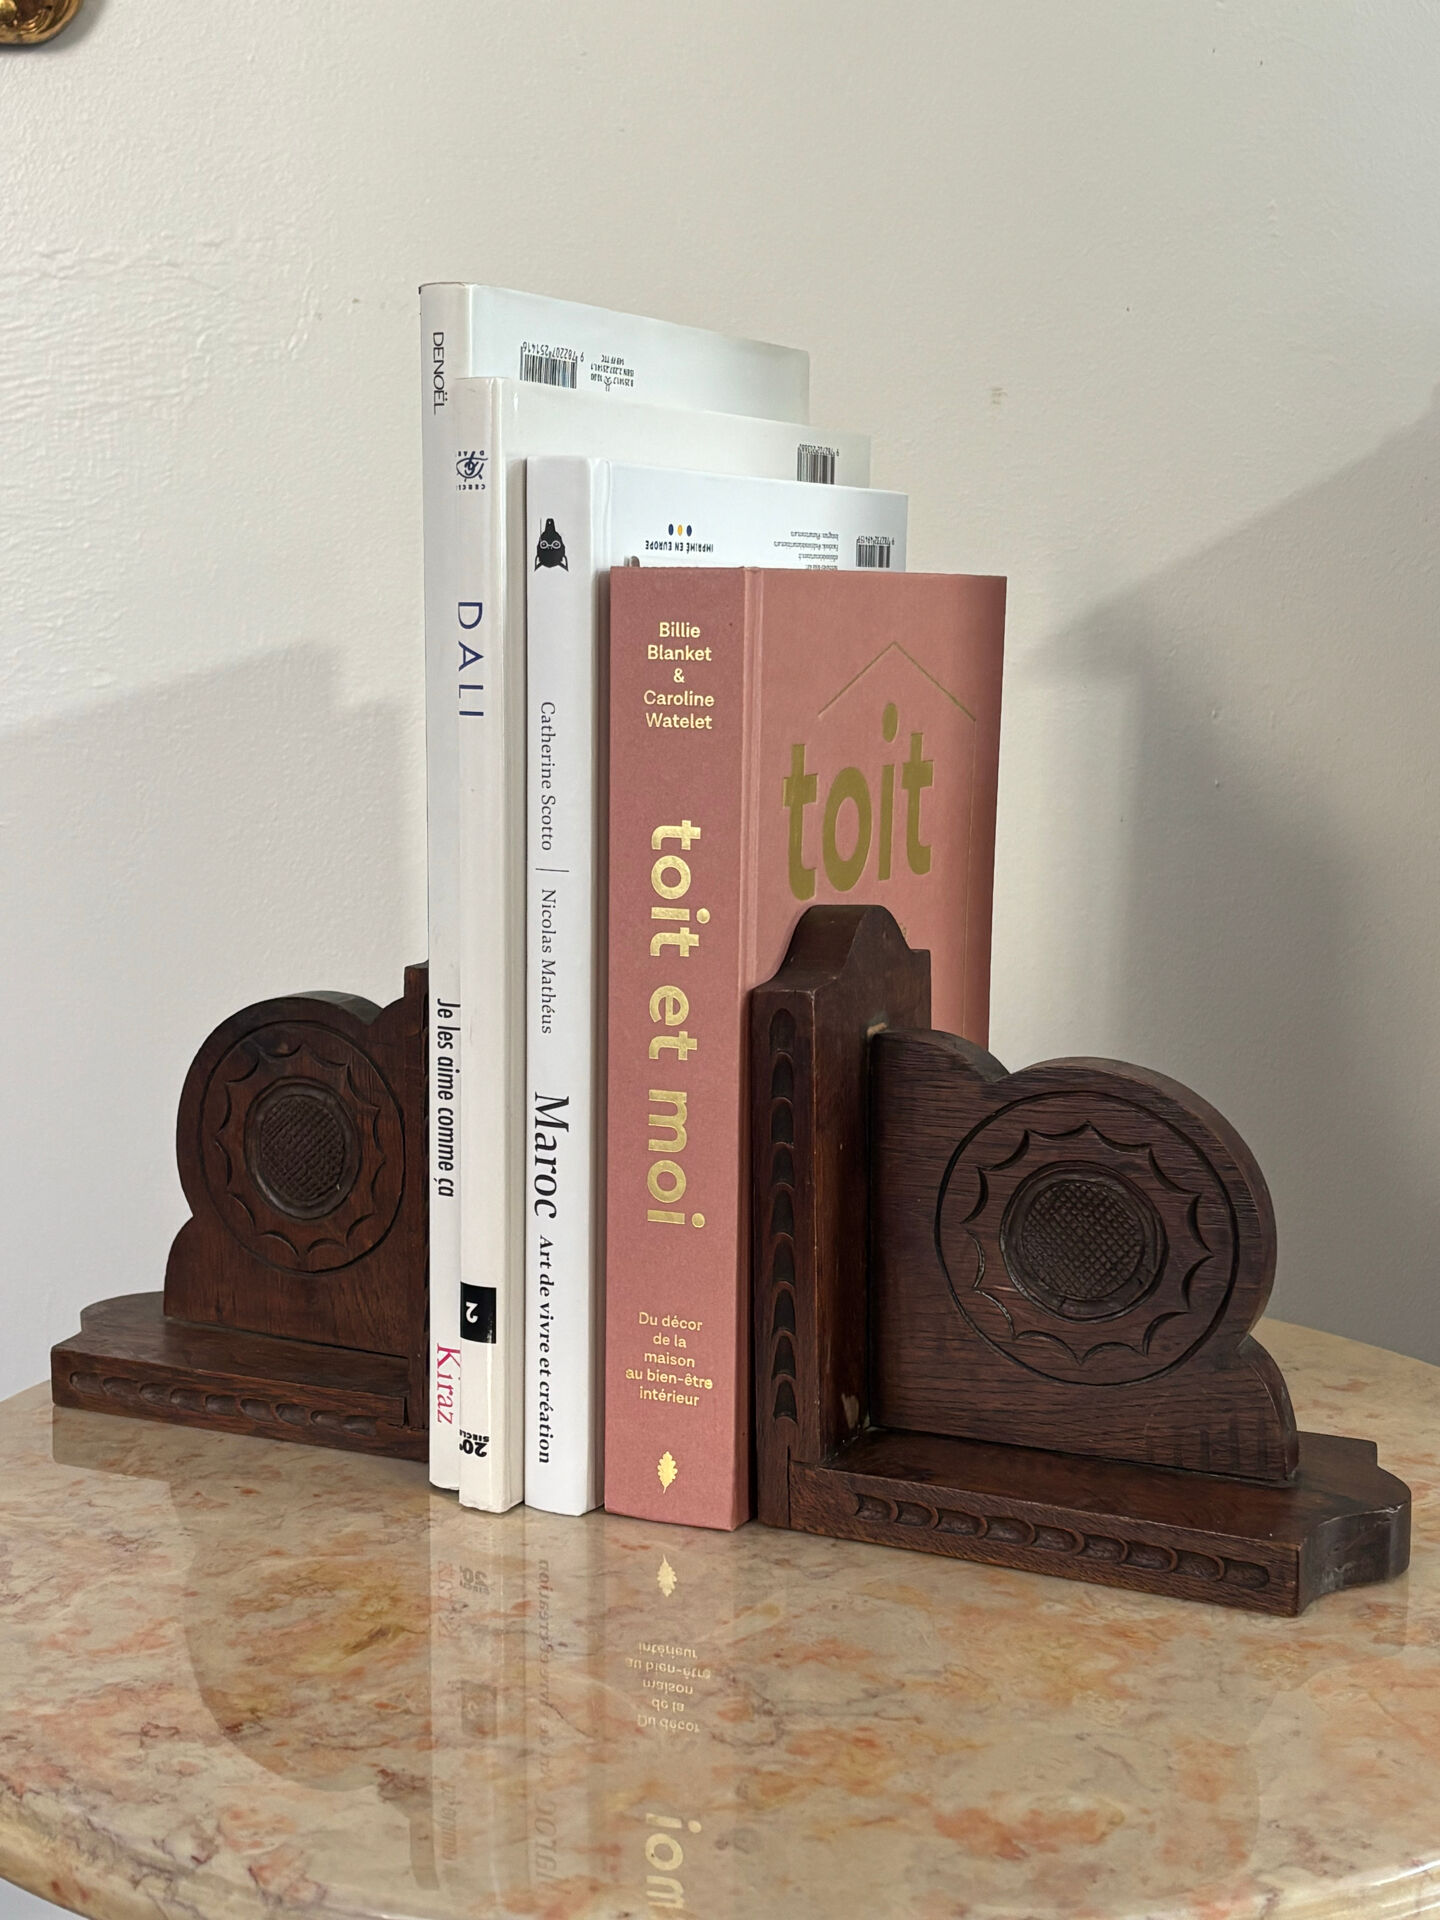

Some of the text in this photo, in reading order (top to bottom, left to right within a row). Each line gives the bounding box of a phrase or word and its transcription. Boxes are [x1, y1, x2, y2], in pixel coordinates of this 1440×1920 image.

[431, 330, 449, 416] DENOËL
[644, 540, 714, 554] IMPRIMÉ EN EUROPE
[658, 622, 701, 639] Billie
[456, 600, 485, 718] DALI
[647, 645, 713, 662] Blanket
[673, 668, 685, 683] &
[643, 690, 715, 707] Caroline
[645, 712, 713, 730] Watelet
[540, 701, 556, 851] Catherine Scotto
[783, 702, 935, 902] toit
[540, 888, 556, 1034] Nicolas Mathéus
[647, 819, 711, 1228] toit et moi
[433, 997, 460, 1197] Je les aime comme ça
[534, 1091, 570, 1219] Maroc
[465, 1301, 479, 1324] 2
[638, 1311, 703, 1331] Du décor
[538, 1235, 555, 1464] Art de vivre et création
[652, 1332, 687, 1348] de la
[644, 1352, 695, 1368] maison
[436, 1342, 462, 1425] Kiraz
[625, 1368, 713, 1390] au bien-être
[639, 1385, 700, 1407] intérieur
